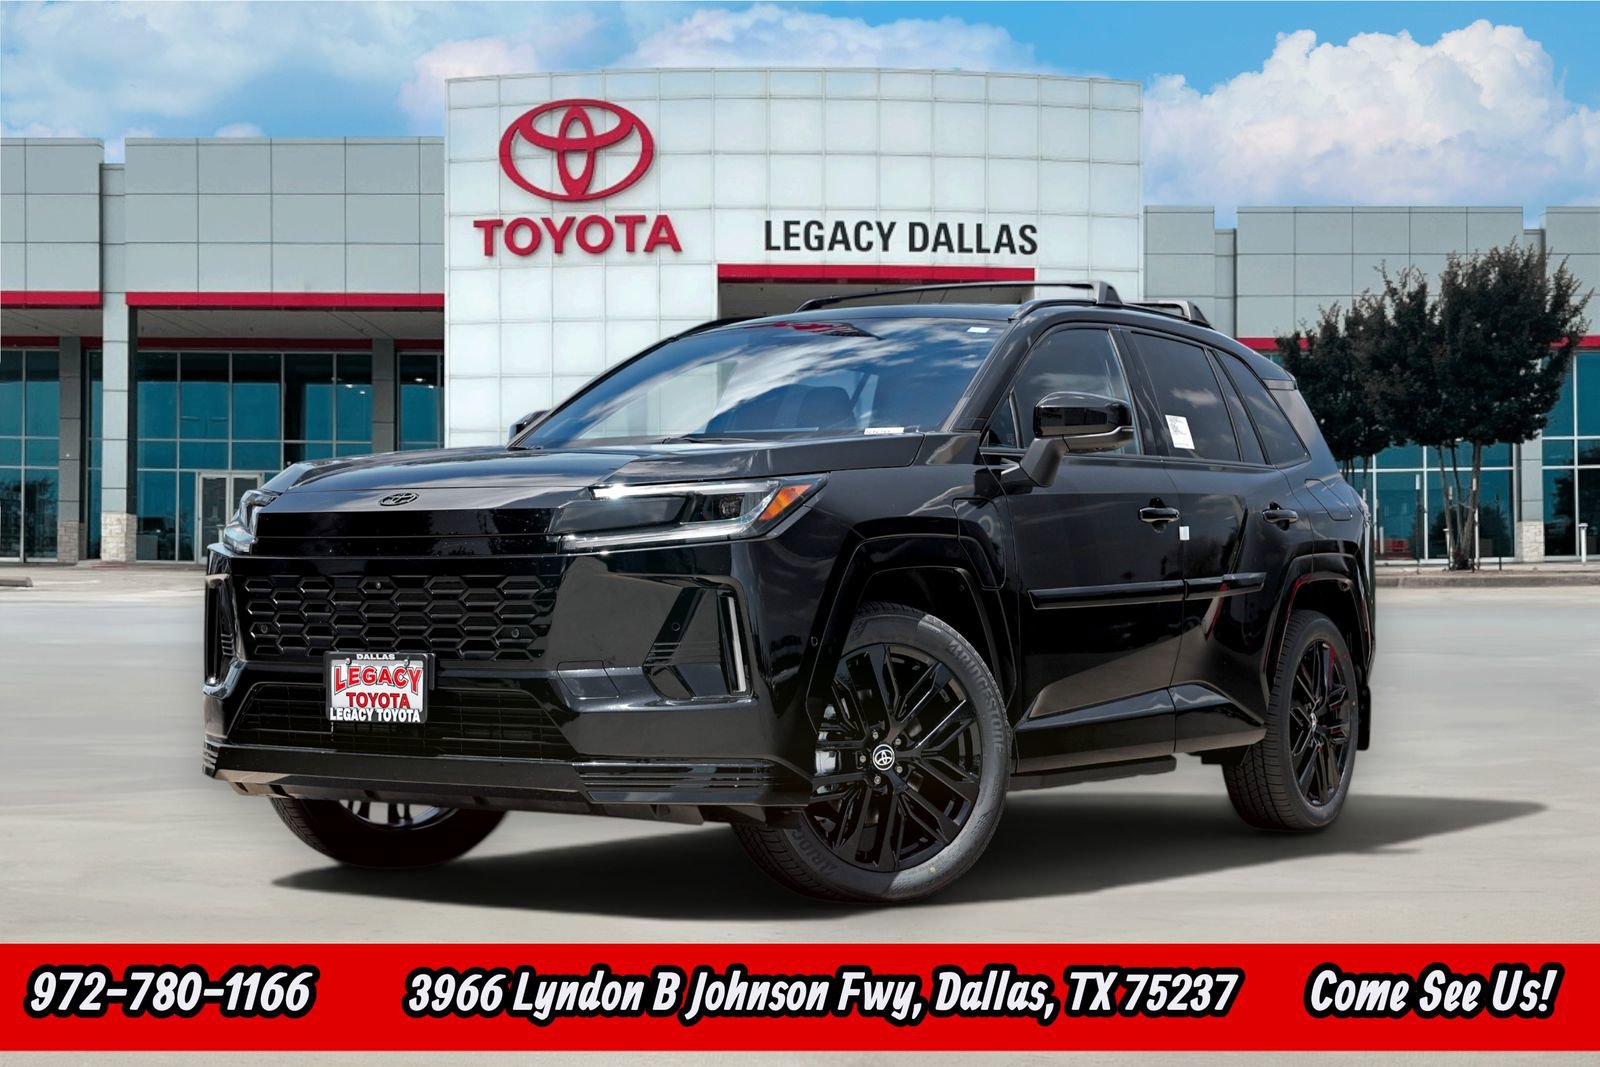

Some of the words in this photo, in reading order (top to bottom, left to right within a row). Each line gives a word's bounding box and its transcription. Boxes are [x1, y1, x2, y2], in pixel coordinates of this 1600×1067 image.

[474, 214, 682, 256] TOYOTA
[765, 220, 897, 252] LEGACY
[908, 221, 1038, 255] DALLAS
[355, 653, 396, 661] DALLAS
[333, 665, 424, 696] LEGACY
[345, 692, 411, 709] TOYOTA
[329, 707, 374, 721] LEGACY
[376, 708, 421, 723] TOYOTA
